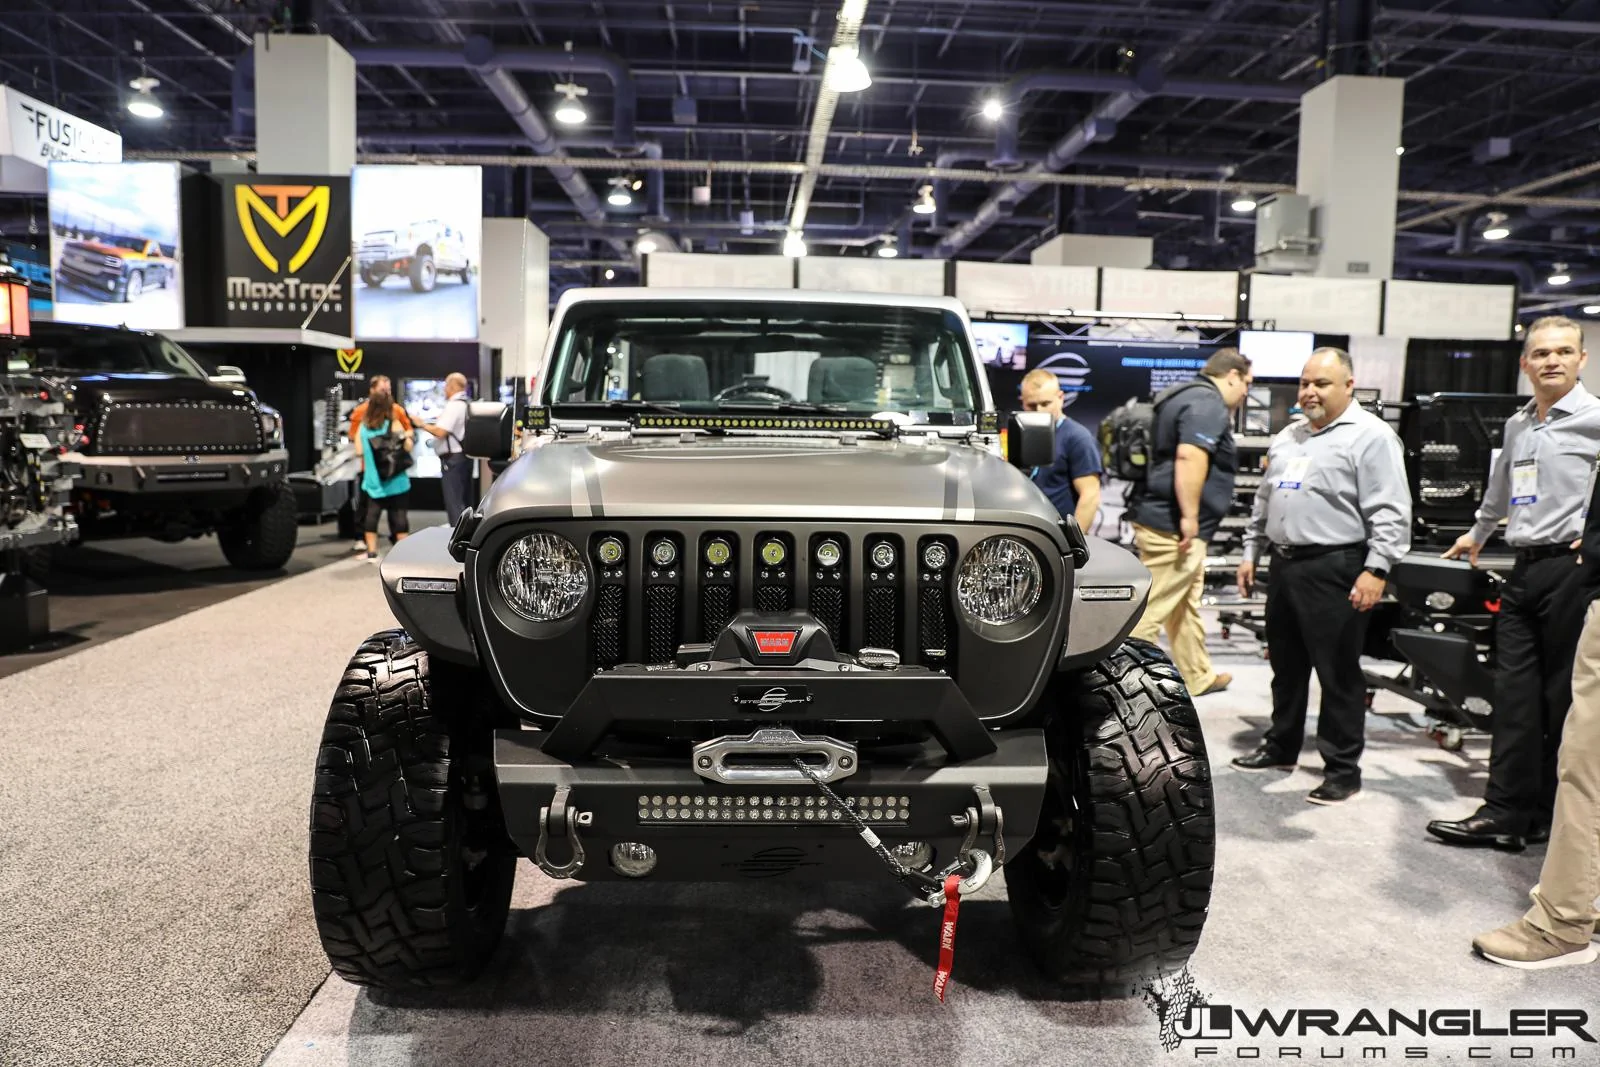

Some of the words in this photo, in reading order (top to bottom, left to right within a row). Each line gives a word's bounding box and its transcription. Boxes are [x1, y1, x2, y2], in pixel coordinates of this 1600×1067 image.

[32, 109, 90, 148] FUSI
[227, 276, 342, 300] MaxTrac
[760, 637, 789, 647] WARN
[941, 921, 955, 950] WARN
